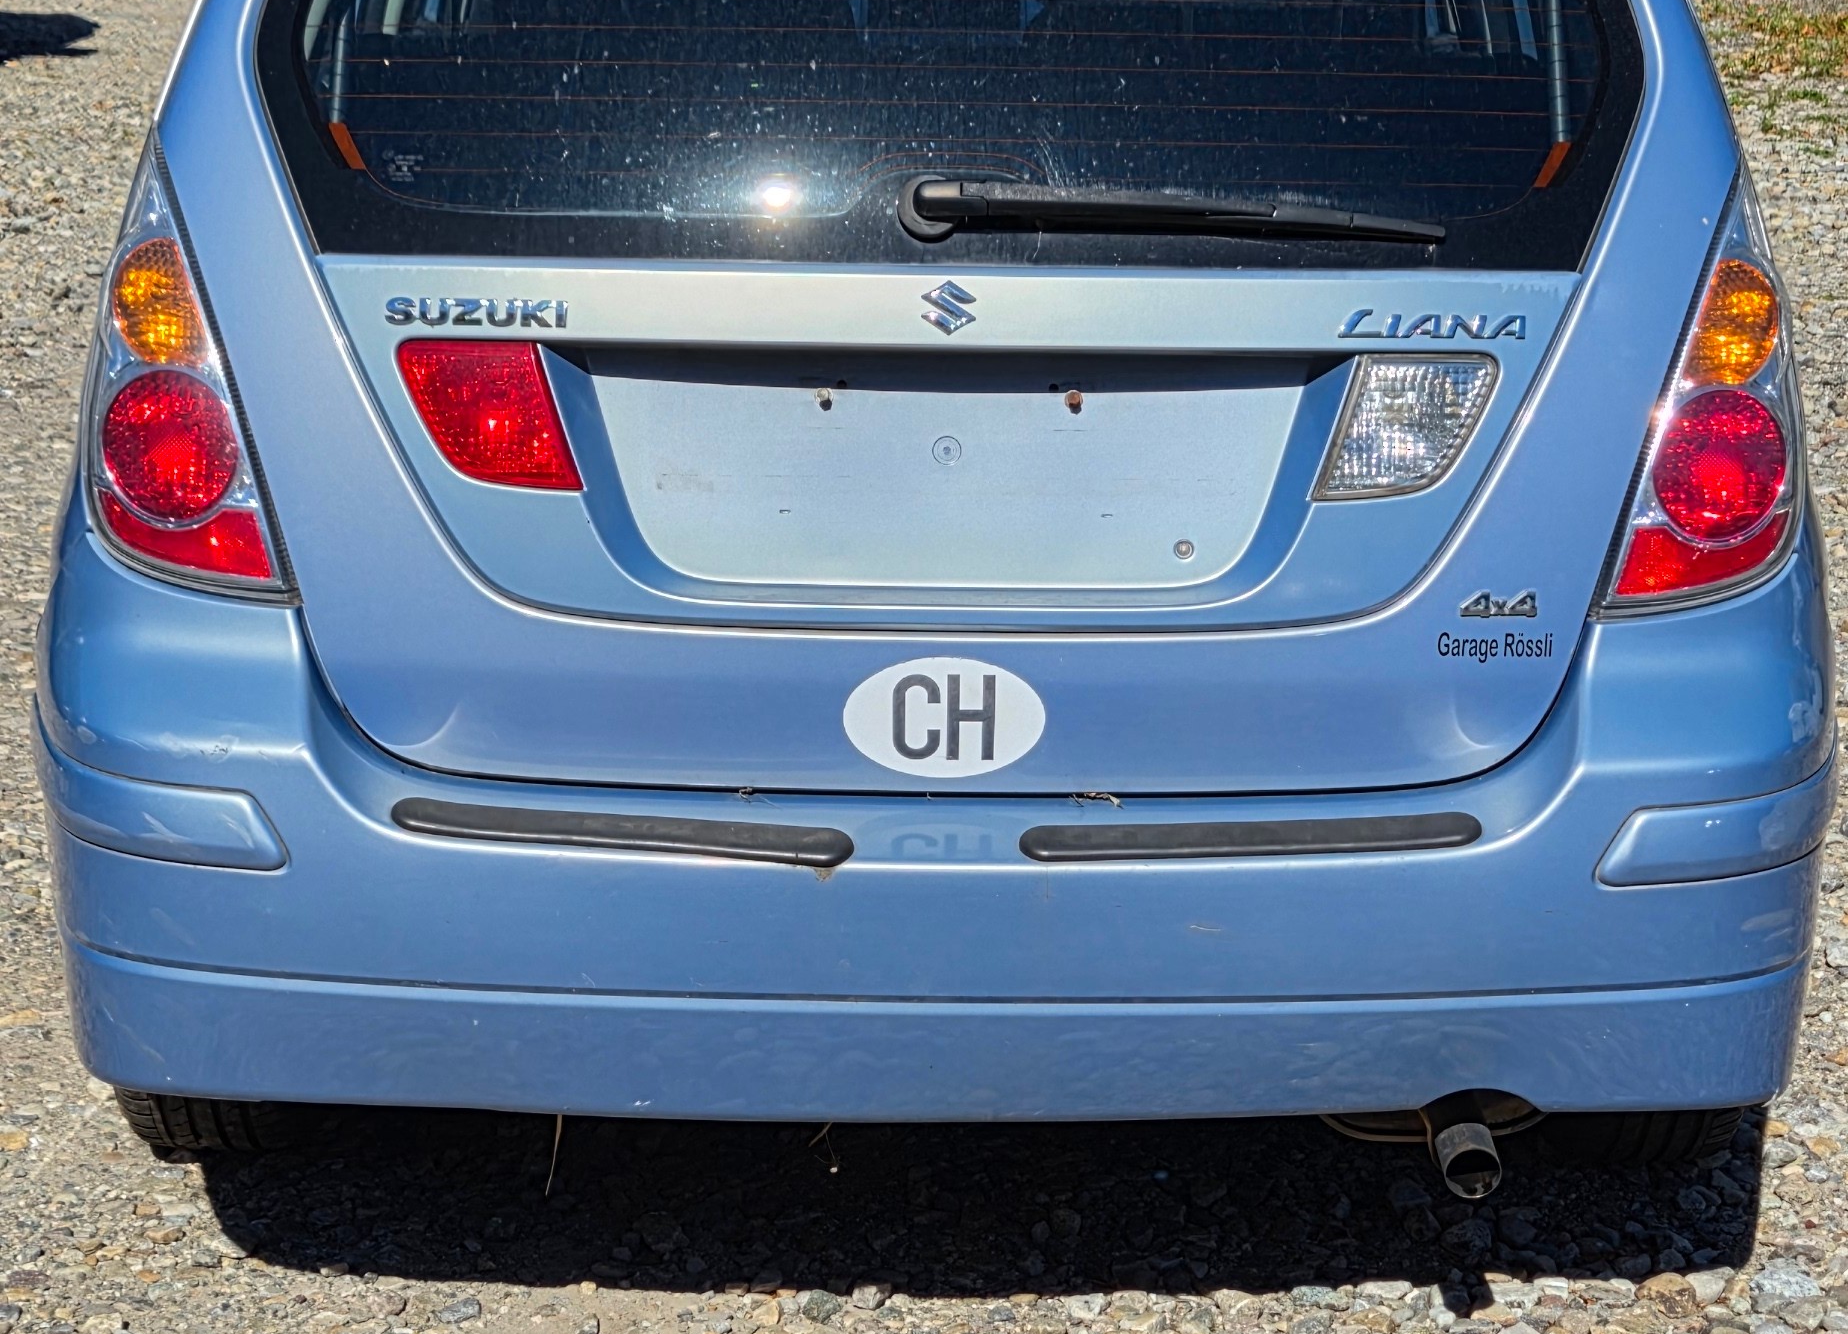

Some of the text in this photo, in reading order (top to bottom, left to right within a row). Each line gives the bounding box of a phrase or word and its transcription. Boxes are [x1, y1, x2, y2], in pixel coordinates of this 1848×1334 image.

[384, 296, 569, 329] SUZUKI
[1337, 308, 1527, 340] LIANA
[1459, 588, 1538, 618] 4x4
[1437, 631, 1553, 663] Garage Rössli
[892, 673, 996, 761] CH
